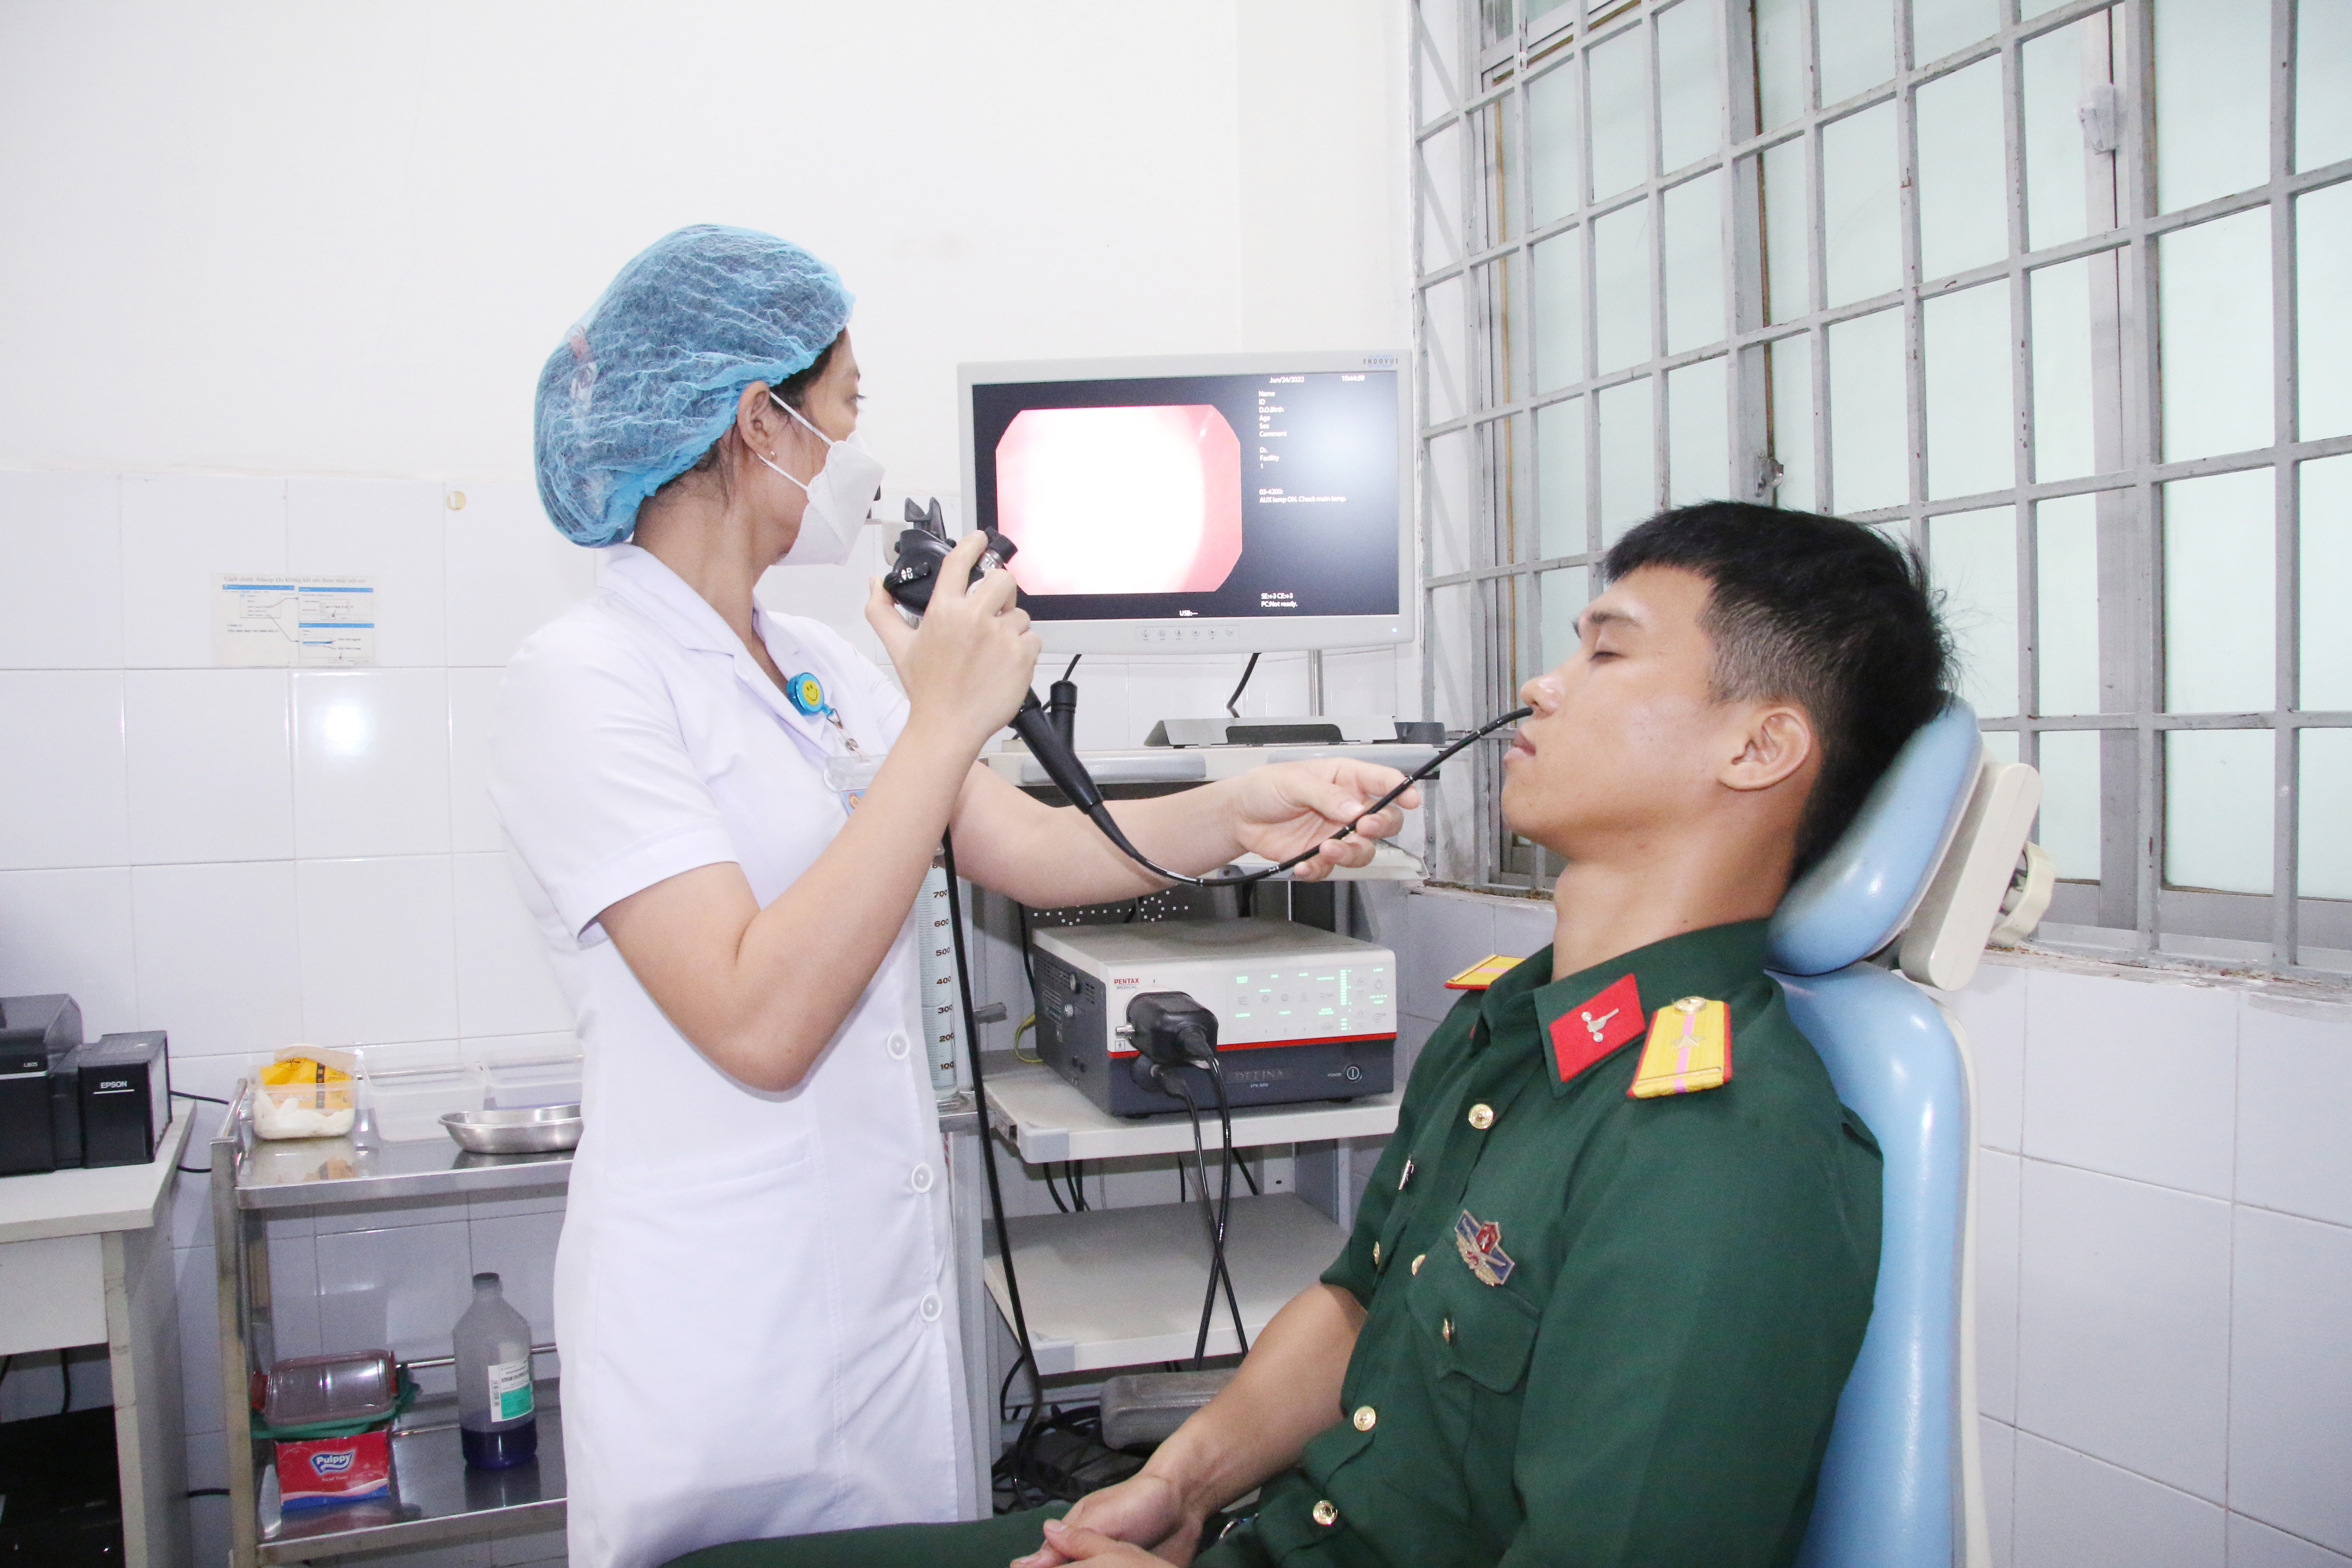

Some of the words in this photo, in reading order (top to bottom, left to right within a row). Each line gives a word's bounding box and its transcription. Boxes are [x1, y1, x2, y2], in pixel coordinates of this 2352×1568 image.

[933, 890, 947, 898] 700
[934, 919, 949, 927] 600
[936, 947, 950, 956] 500
[937, 976, 951, 984] 400
[938, 1004, 952, 1014] 300
[939, 1033, 953, 1042] 200
[940, 1062, 954, 1070] 100
[101, 1081, 127, 1089] EPSON
[316, 1455, 351, 1466] Pulppy
